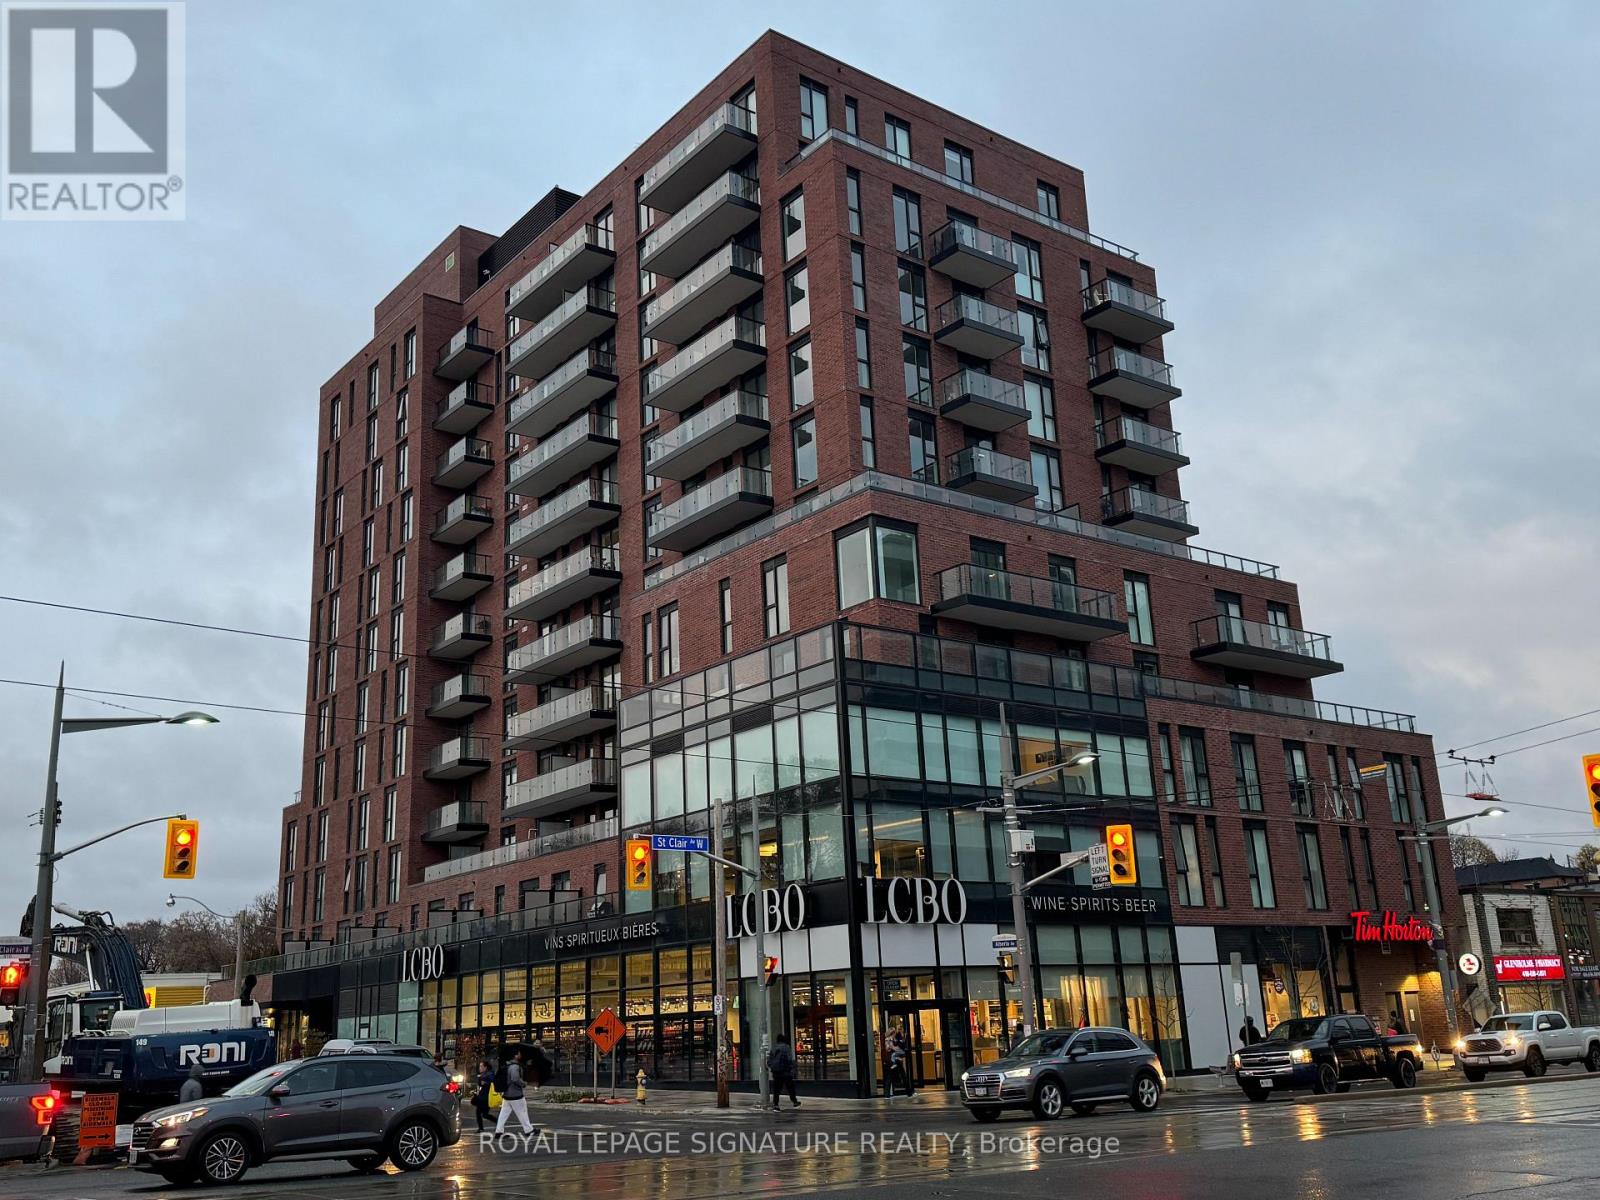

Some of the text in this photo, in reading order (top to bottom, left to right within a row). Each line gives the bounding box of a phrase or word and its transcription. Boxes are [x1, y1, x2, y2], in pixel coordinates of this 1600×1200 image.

[657, 837, 666, 848] St
[668, 837, 688, 849] Clair
[696, 839, 704, 849] W
[1091, 846, 1104, 856] LEFT
[1091, 856, 1107, 865] TURN
[1091, 865, 1109, 875] SIGNAL
[726, 884, 805, 939] LCBO
[864, 876, 967, 925] LCBO
[1030, 896, 1157, 912] WINE SPIRITS BEER
[544, 922, 657, 950] VINS SPIRITUEUX BIÈRES
[1350, 910, 1435, 942] Tim Horton
[402, 944, 443, 982] LCBO
